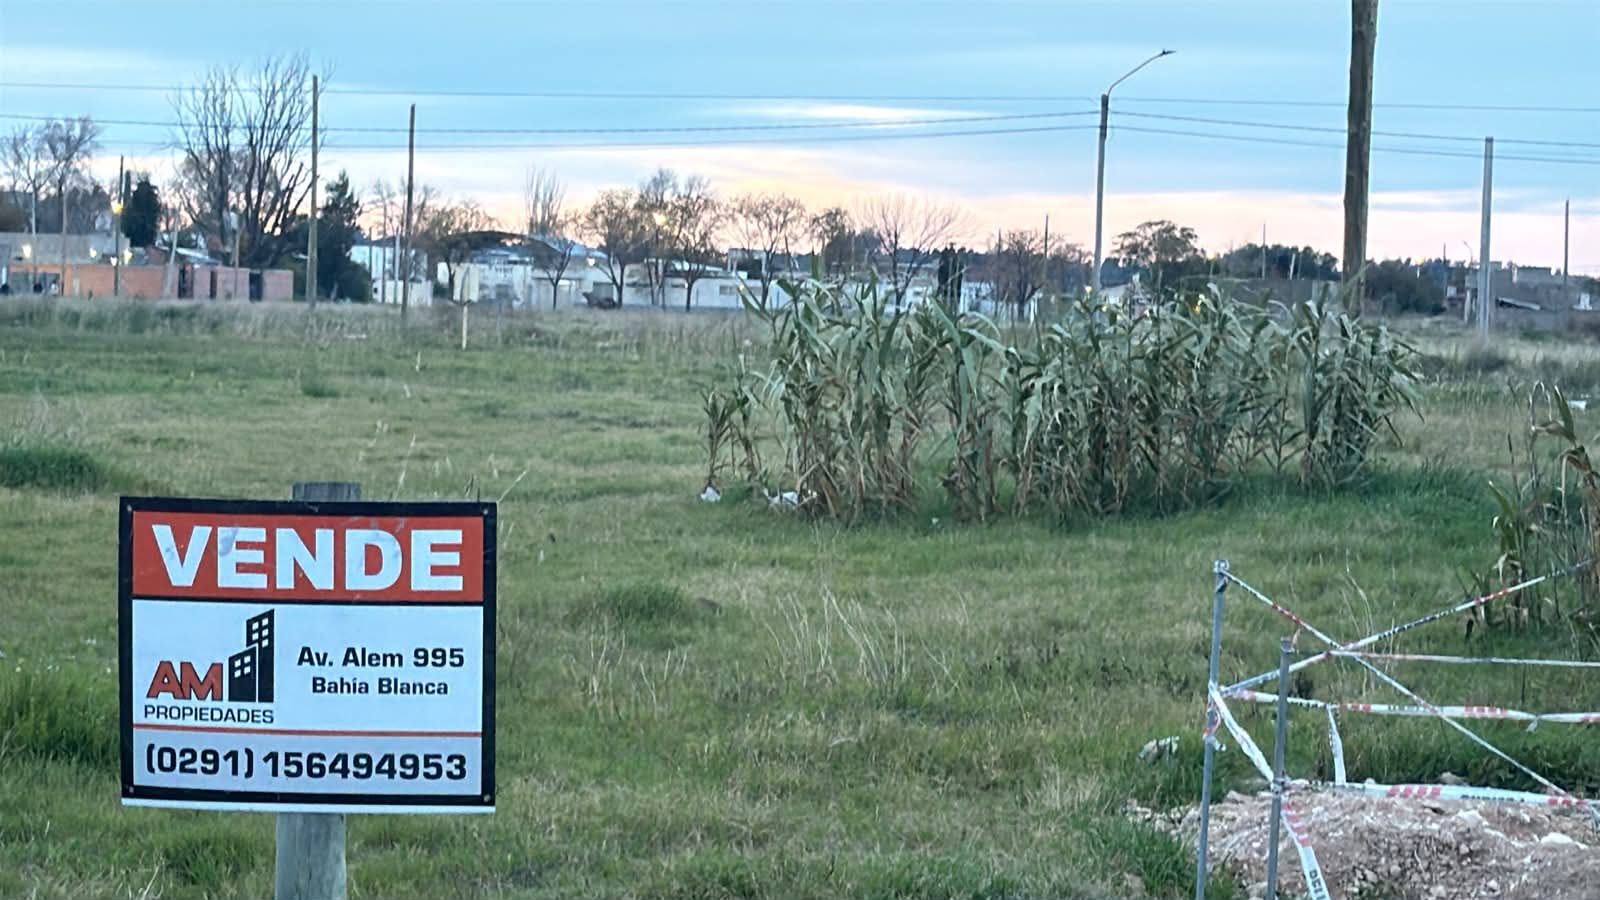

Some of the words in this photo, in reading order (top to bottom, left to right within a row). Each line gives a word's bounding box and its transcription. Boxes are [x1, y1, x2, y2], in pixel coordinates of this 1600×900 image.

[151, 523, 464, 592] VENDE
[297, 647, 334, 668] Av.
[342, 647, 404, 668] Alem
[413, 648, 465, 668] 995
[146, 660, 224, 702] AM
[312, 677, 370, 695] Bahía
[378, 679, 449, 695] Blanca
[143, 705, 275, 724] PROPIEDADES
[146, 743, 254, 779] (0291)
[262, 751, 467, 780] 156494953
